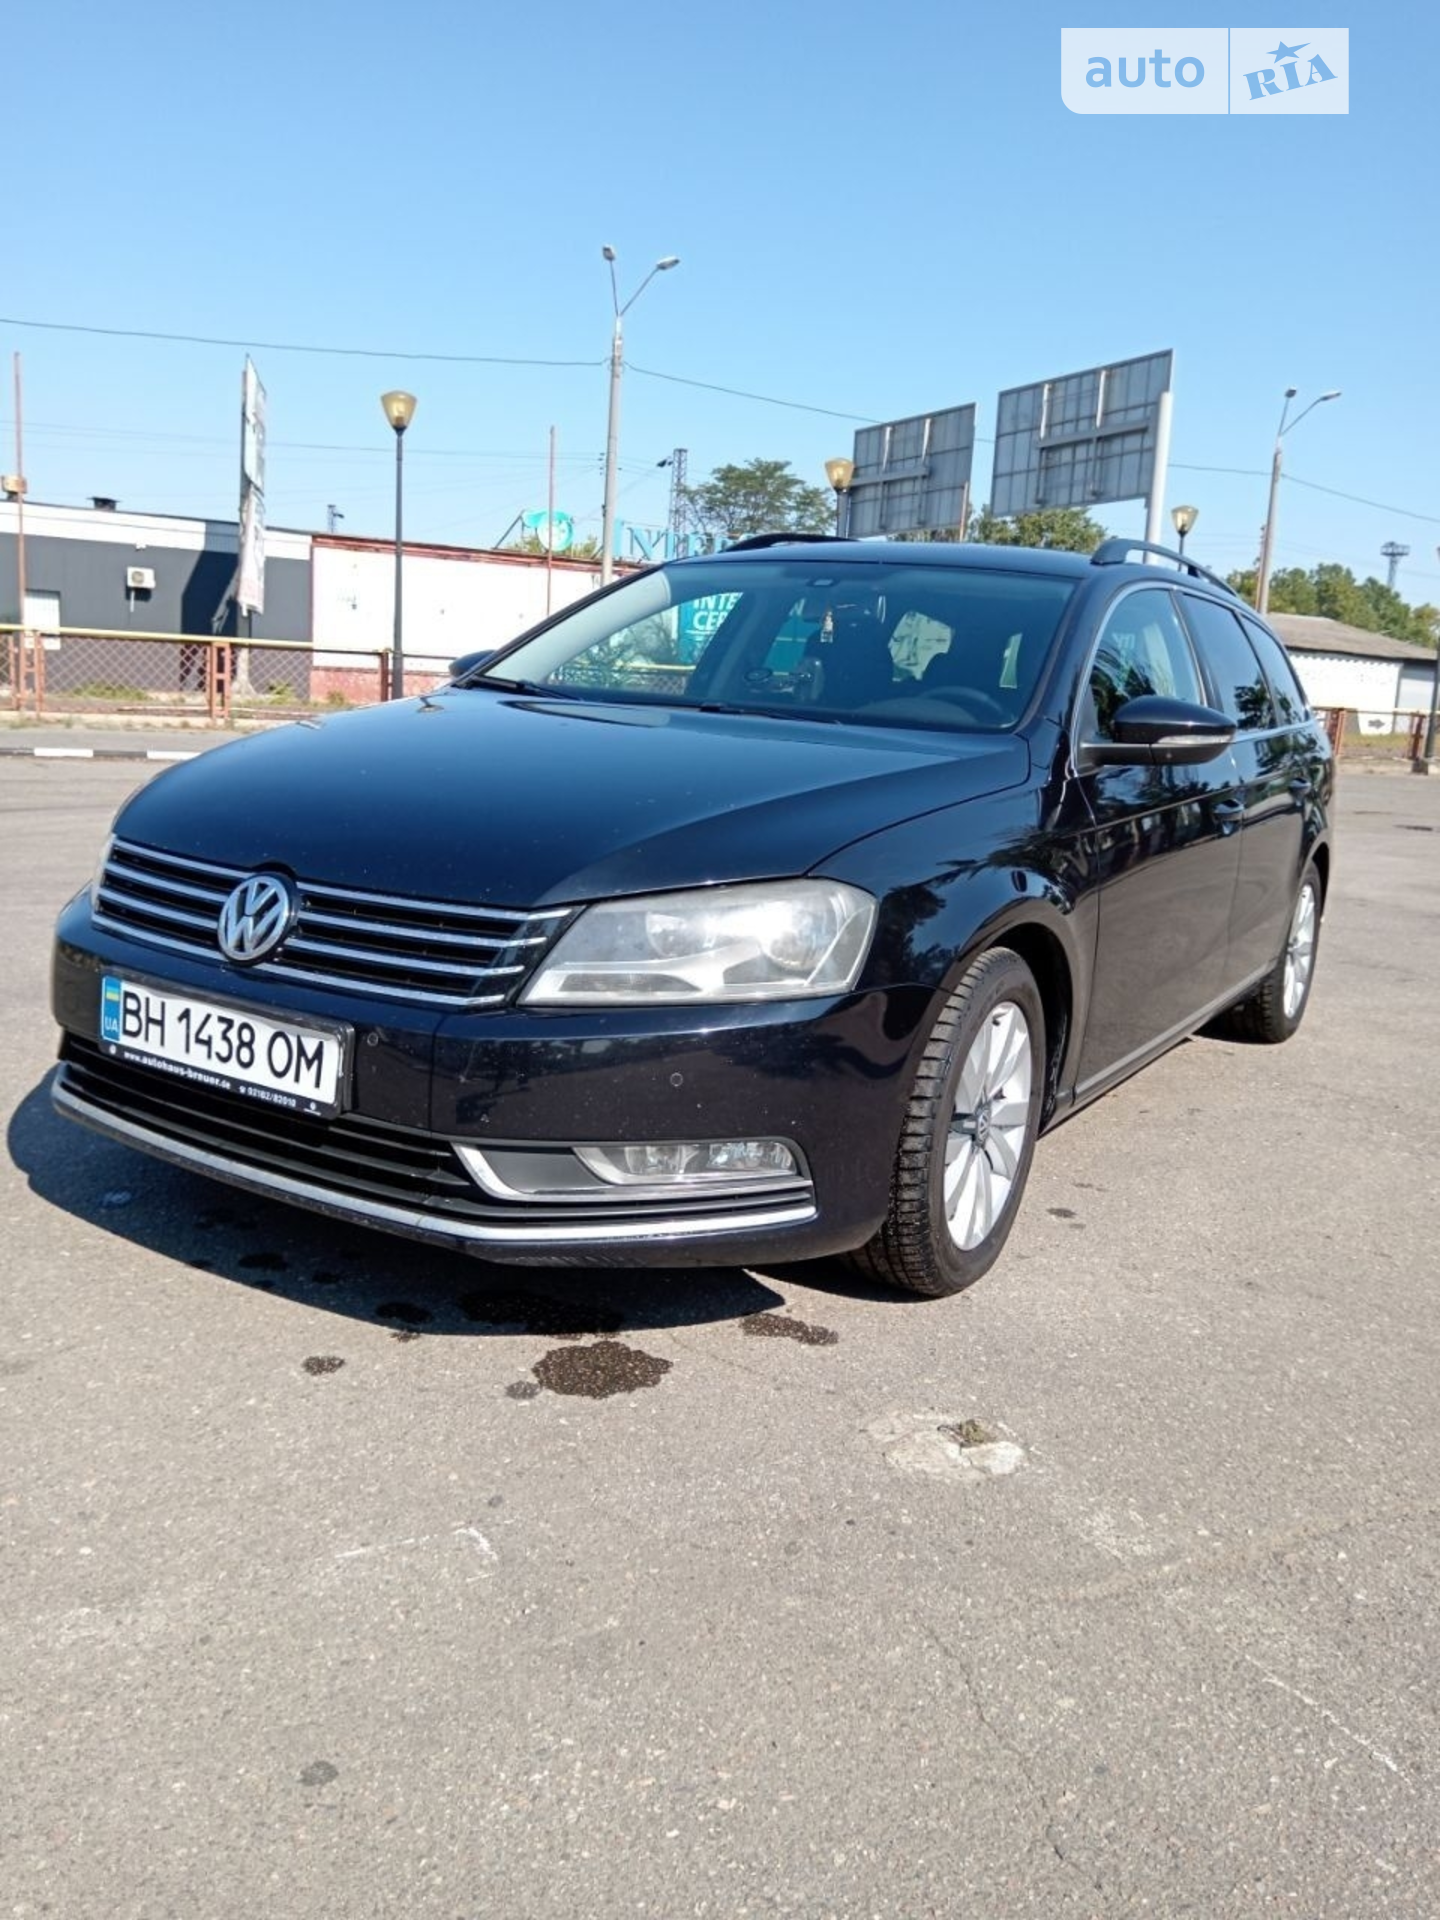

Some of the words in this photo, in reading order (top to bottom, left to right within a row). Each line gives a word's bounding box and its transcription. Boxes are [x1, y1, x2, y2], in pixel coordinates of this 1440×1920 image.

[104, 1016, 119, 1032] UA
[122, 990, 166, 1048] BH
[177, 1007, 256, 1070] 1438
[267, 1030, 324, 1089] OM
